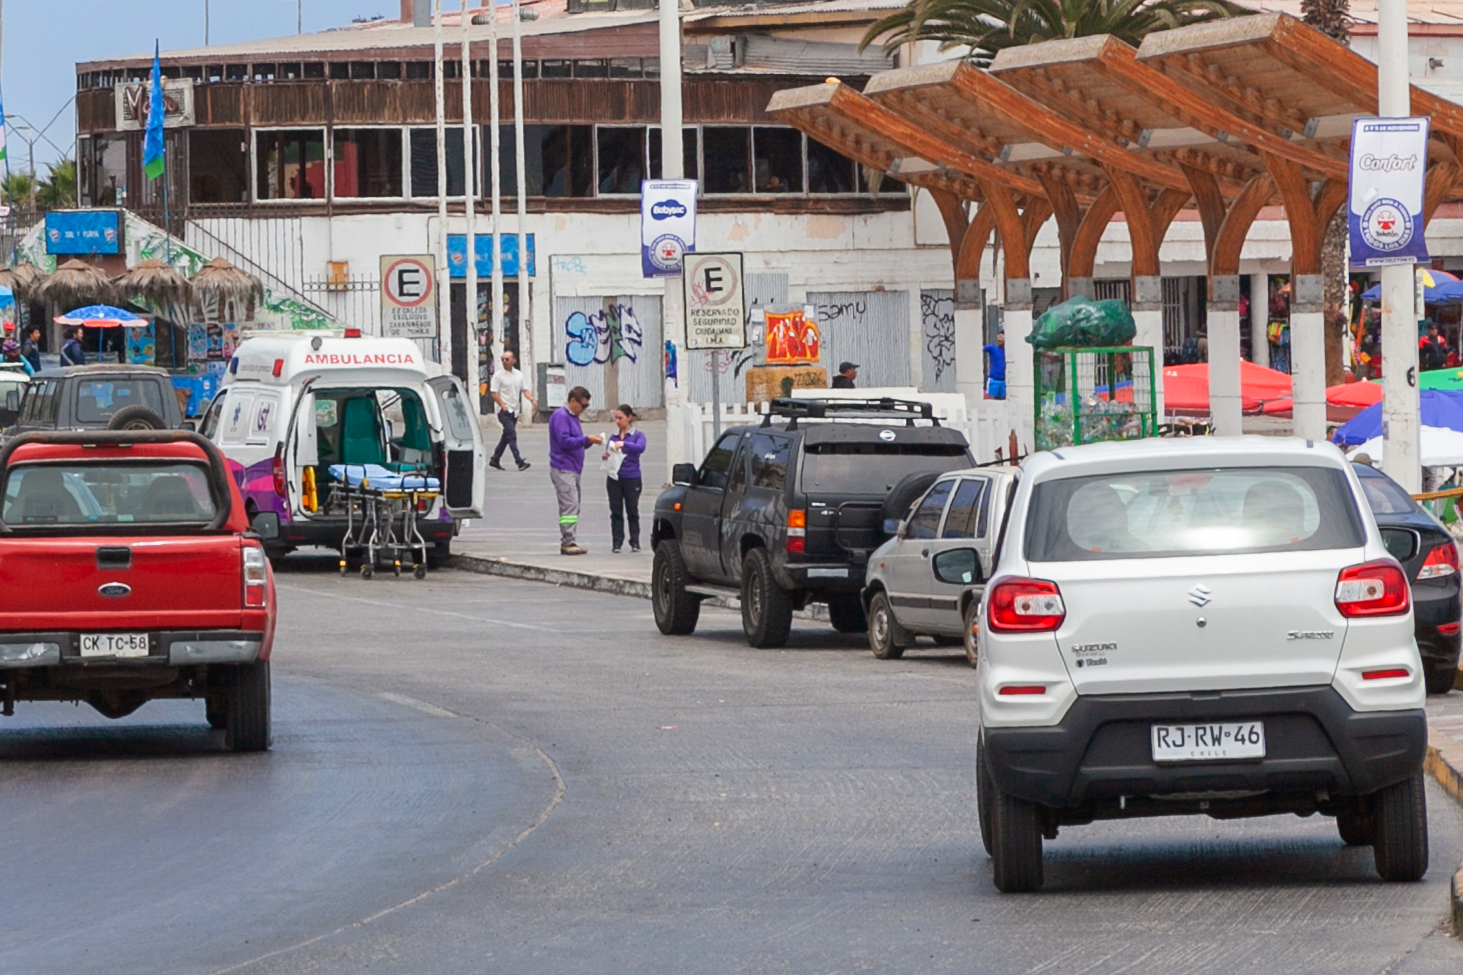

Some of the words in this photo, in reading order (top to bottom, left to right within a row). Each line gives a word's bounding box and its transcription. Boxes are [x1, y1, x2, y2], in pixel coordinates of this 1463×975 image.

[1359, 154, 1418, 173] Confort
[398, 269, 420, 297] E
[704, 267, 723, 292] E
[693, 318, 737, 326] SEGURIDAD
[304, 354, 414, 364] AMBULANCIA
[1071, 643, 1117, 652] SUZUKI
